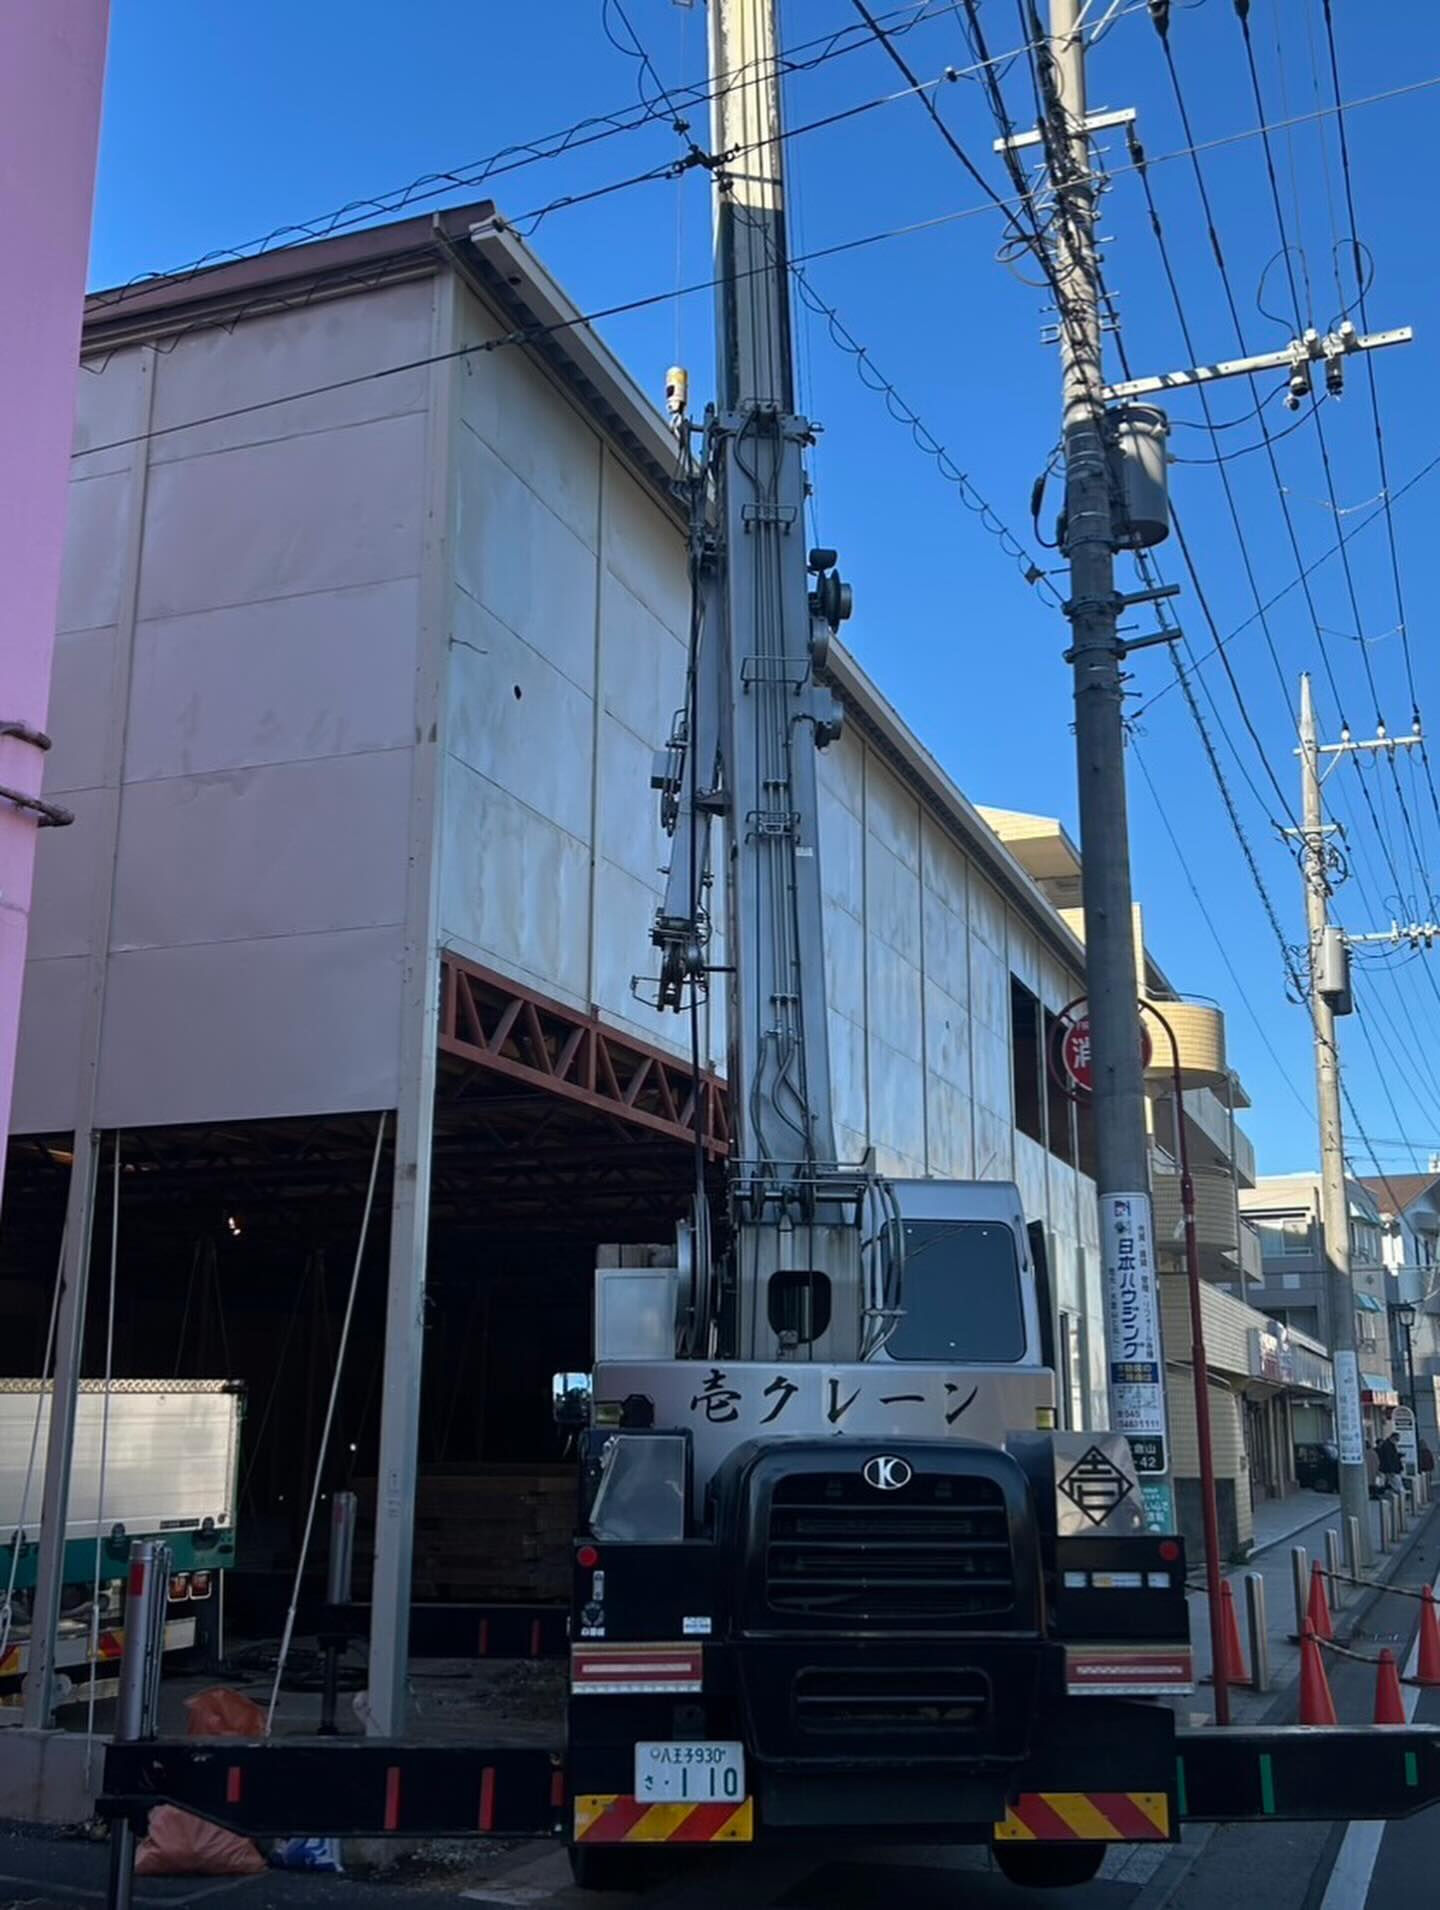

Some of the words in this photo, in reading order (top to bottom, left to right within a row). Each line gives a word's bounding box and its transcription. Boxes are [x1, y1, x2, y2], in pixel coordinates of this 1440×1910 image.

[1118, 1238, 1145, 1359] 日本ハウジング
[690, 1368, 978, 1424] 壱クレーン
